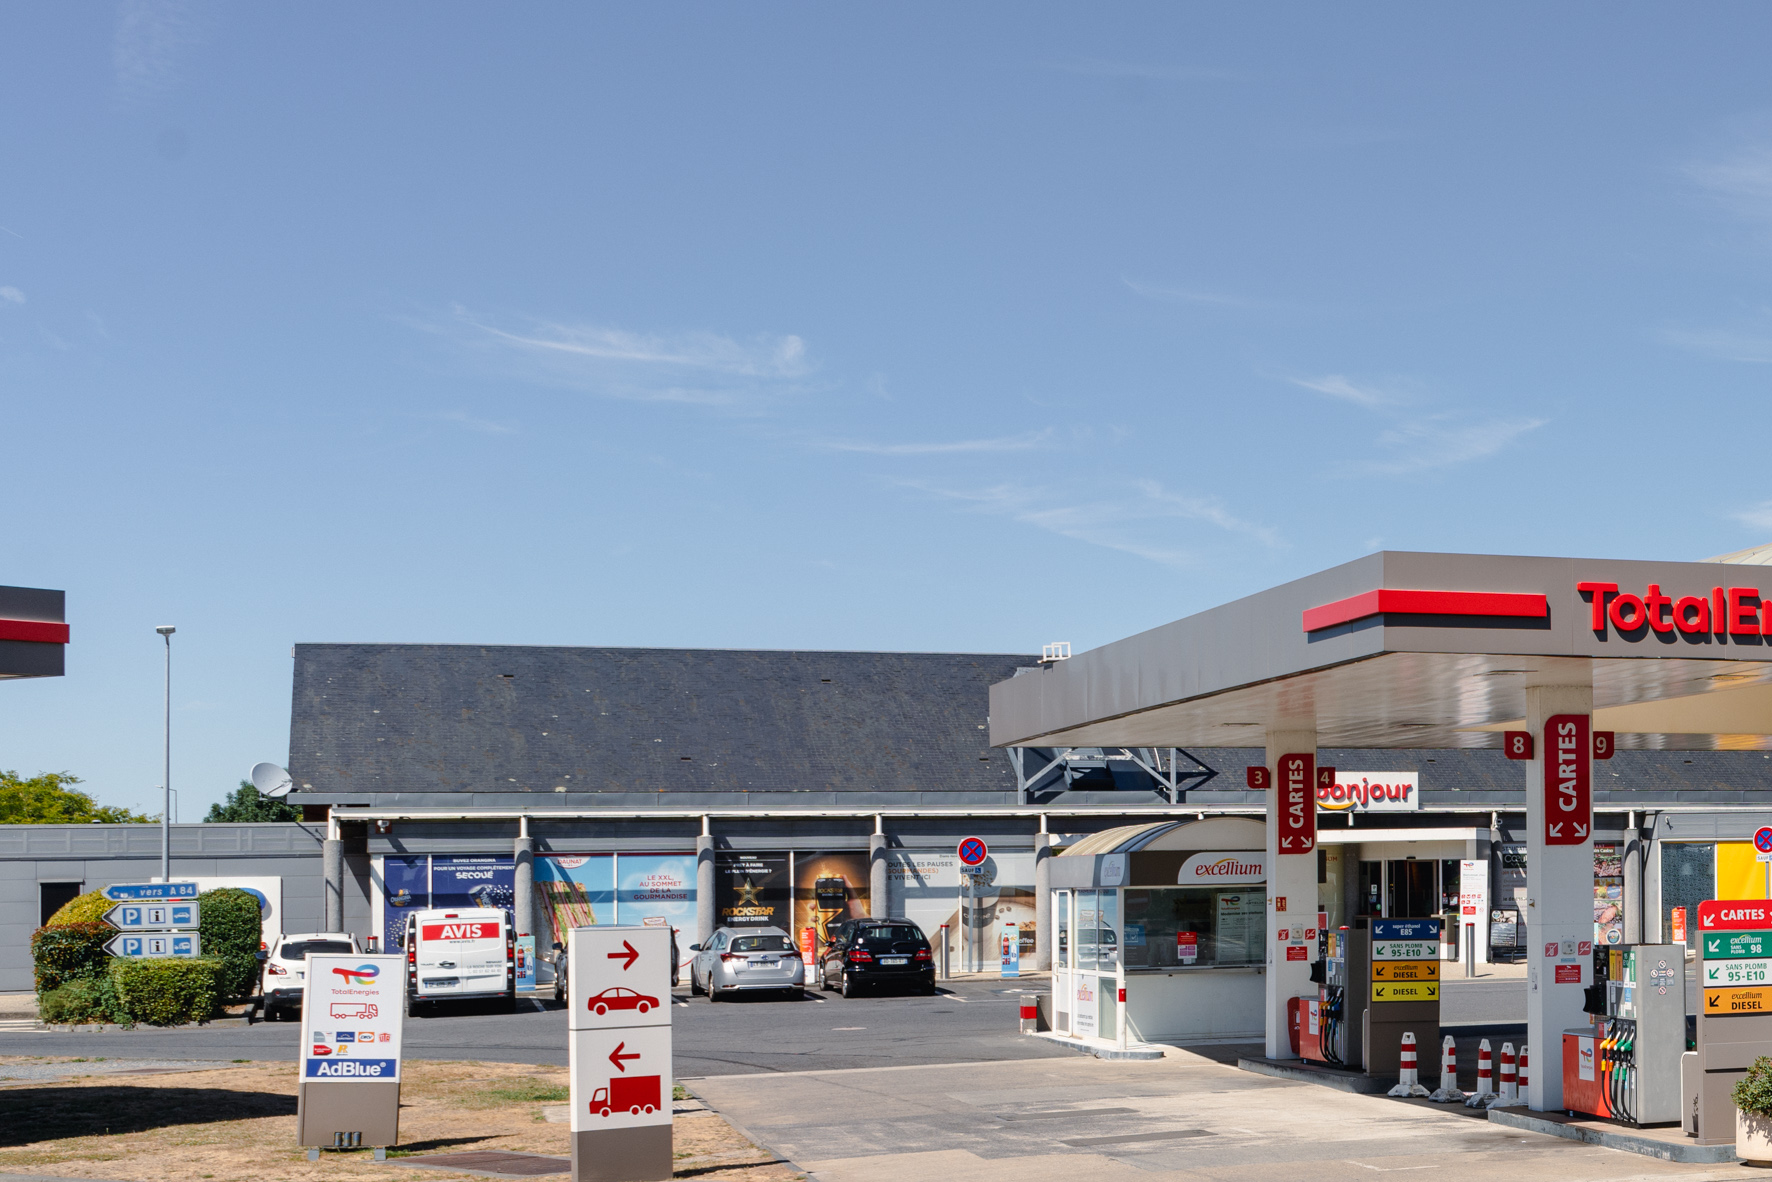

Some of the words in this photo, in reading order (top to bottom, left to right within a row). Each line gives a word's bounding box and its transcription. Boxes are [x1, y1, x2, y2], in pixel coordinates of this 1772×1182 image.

[1513, 736, 1524, 753] 8
[1596, 737, 1607, 754] 9
[1557, 722, 1577, 812] CARTES
[1254, 771, 1263, 784] 3
[1320, 771, 1330, 784] 4
[1288, 759, 1304, 828] CARTES
[1195, 858, 1262, 877] excellium
[658, 874, 674, 882] XXL,
[140, 888, 162, 896] vers
[170, 887, 177, 895] A
[180, 886, 193, 895] 84
[126, 909, 138, 923] P
[722, 906, 775, 916] ROCKSTAR
[1720, 908, 1765, 921] CARTES
[440, 924, 482, 939] AVIS
[1400, 928, 1413, 936] E85
[1730, 934, 1762, 944] excellium
[126, 940, 139, 954] P
[1391, 949, 1421, 957] 95-E10
[1750, 944, 1762, 953] 98
[1728, 970, 1765, 981] 95-E10
[331, 988, 379, 996] TotalEnergies
[1731, 990, 1762, 1000] excellium
[1731, 1001, 1762, 1010] DIESEL
